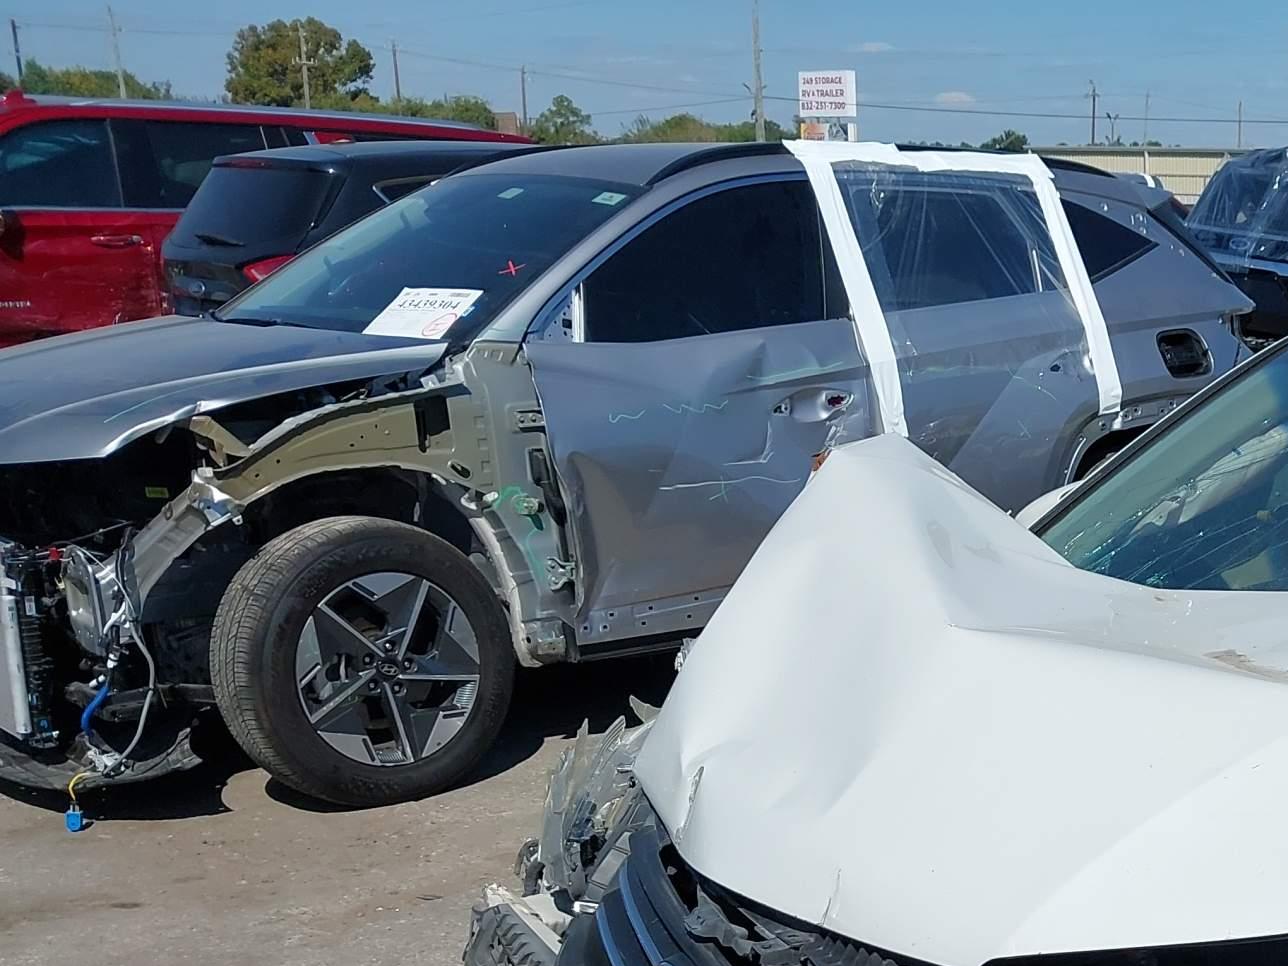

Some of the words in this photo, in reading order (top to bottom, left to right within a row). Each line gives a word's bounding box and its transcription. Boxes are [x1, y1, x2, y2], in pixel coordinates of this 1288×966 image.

[814, 76, 843, 85] STORAGE
[801, 89, 811, 98] RV
[816, 89, 845, 98] TRAILER
[398, 299, 461, 310] 43439304
